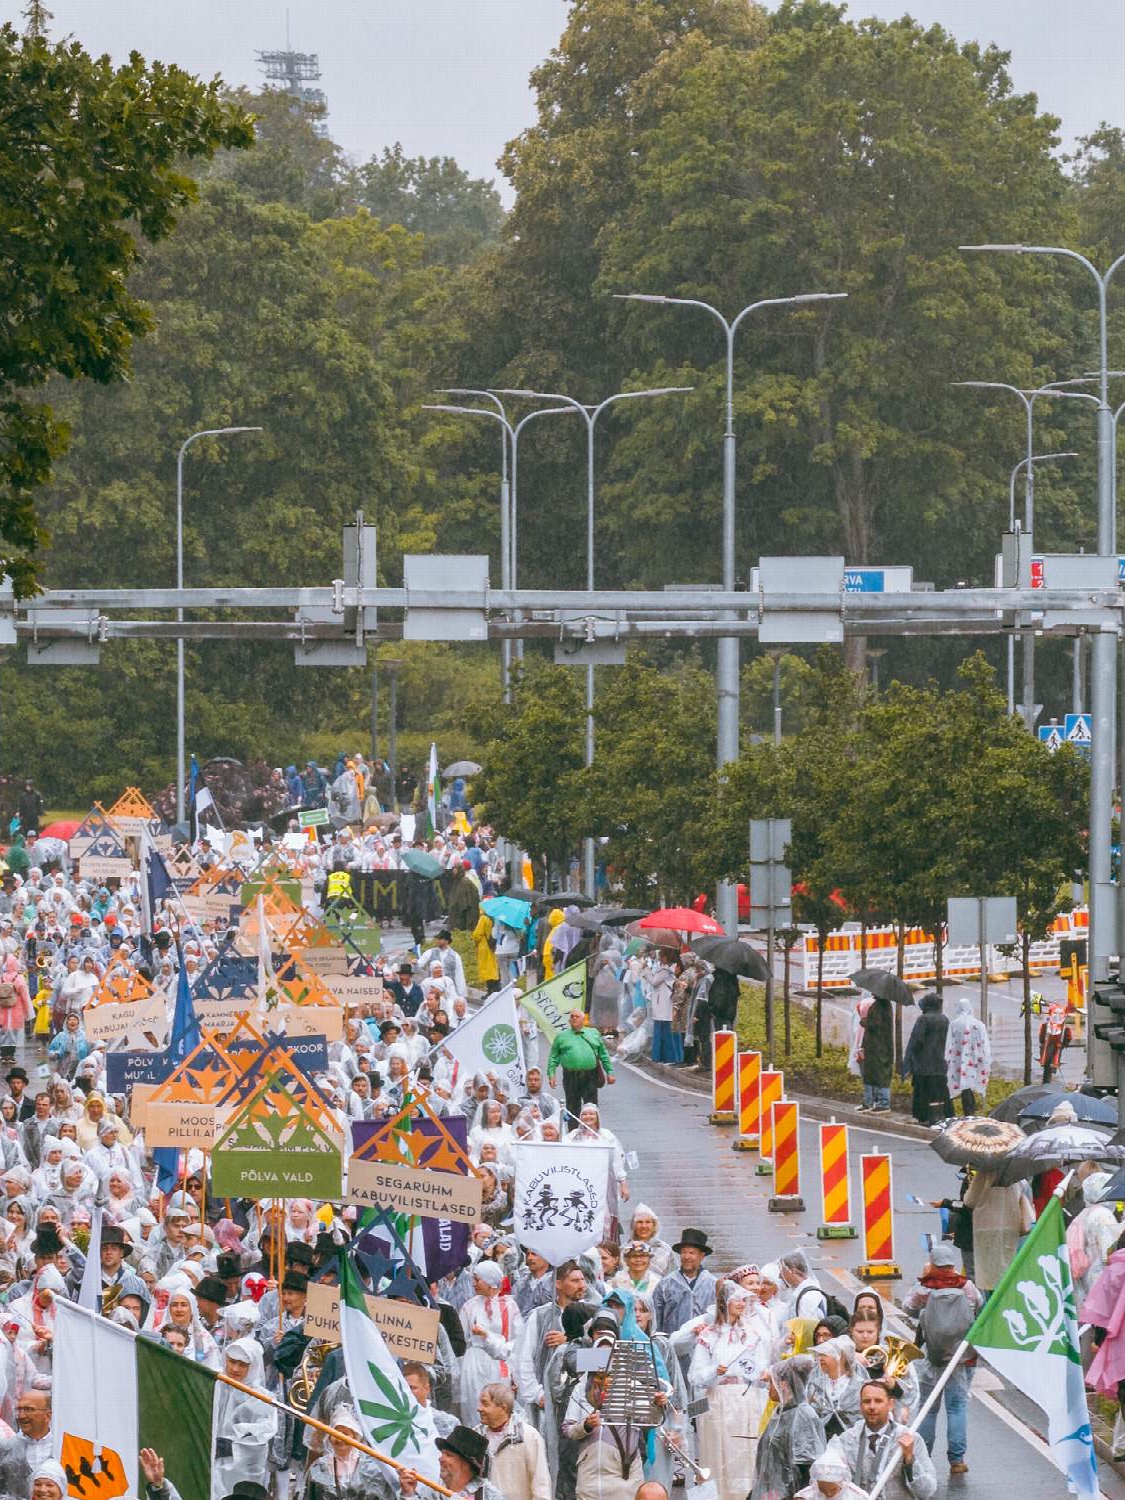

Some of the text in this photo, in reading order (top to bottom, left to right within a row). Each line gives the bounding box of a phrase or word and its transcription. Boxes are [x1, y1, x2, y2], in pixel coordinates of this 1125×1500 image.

[128, 1057, 154, 1067] PÕLV
[180, 1116, 215, 1126] MOOS
[241, 1170, 313, 1183] PÕLVA VALD
[376, 1175, 453, 1197] SEGARÜHM
[351, 1188, 476, 1217] KABUVILISTLASED
[438, 1218, 452, 1252] ALAD
[375, 1313, 413, 1330] LINNA
